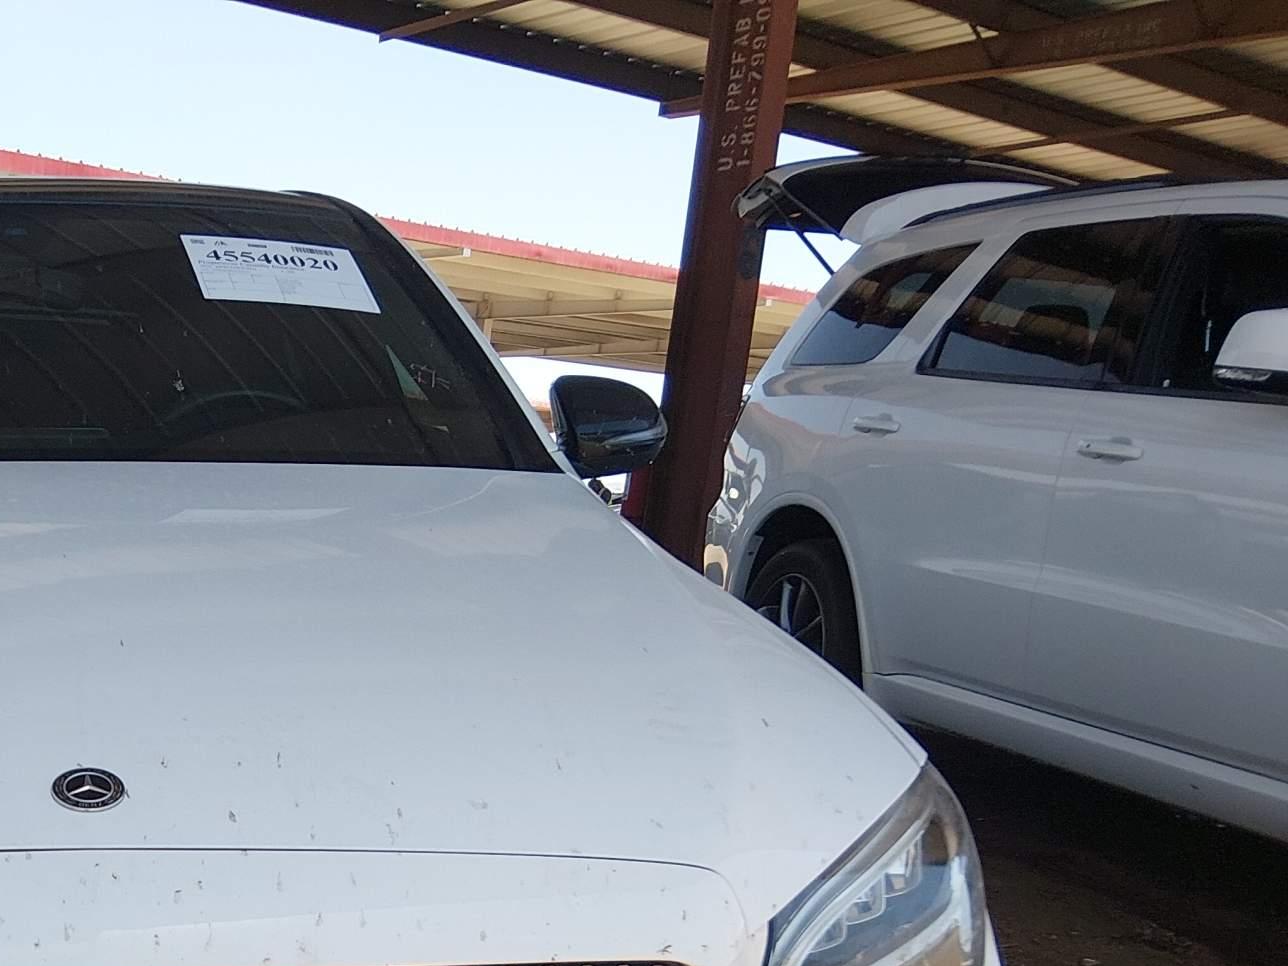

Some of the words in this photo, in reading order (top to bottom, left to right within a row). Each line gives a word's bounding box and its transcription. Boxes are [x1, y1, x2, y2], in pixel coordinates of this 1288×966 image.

[726, 17, 753, 113] PREFAB
[717, 125, 739, 172] U.S.
[205, 249, 339, 272] 45540020
